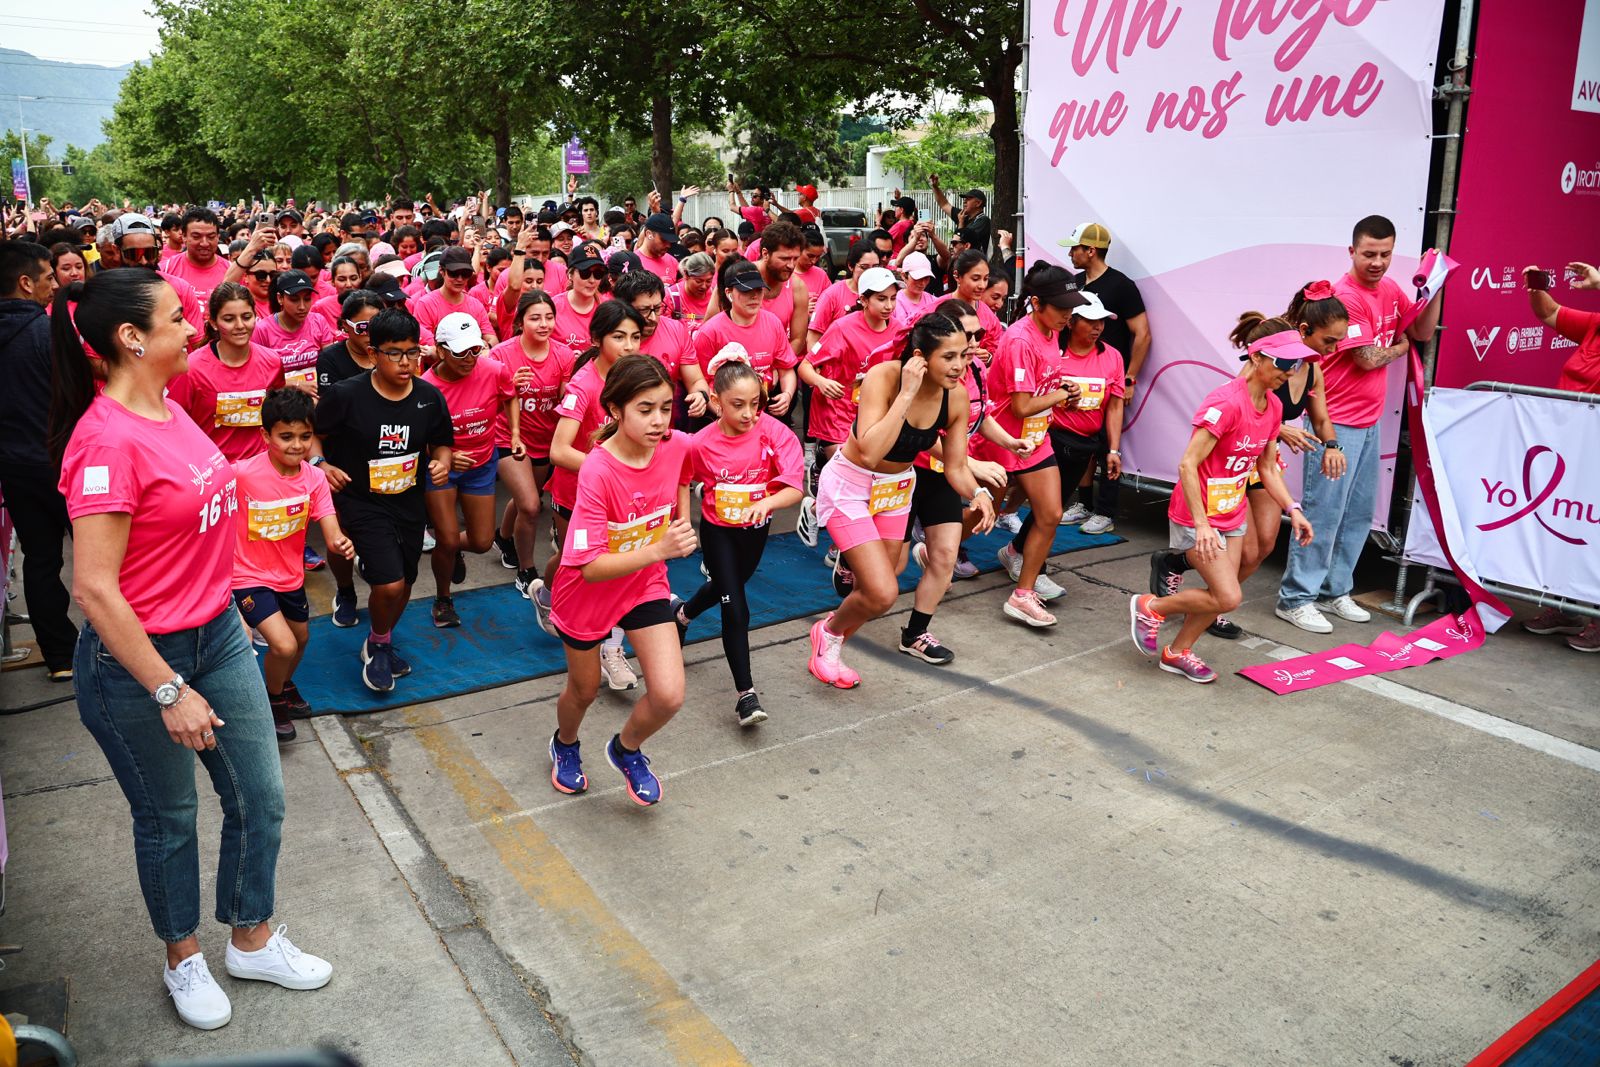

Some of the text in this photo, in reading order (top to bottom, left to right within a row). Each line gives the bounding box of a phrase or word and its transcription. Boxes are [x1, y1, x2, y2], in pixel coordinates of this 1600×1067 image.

[1049, 62, 1384, 167] que nos une
[281, 351, 318, 364] VOLUTION
[320, 373, 328, 383] G
[379, 440, 408, 450] FUN
[1480, 478, 1517, 507] Yo
[873, 493, 905, 511] 1866
[290, 506, 300, 514] 3K
[258, 518, 300, 539] 1237
